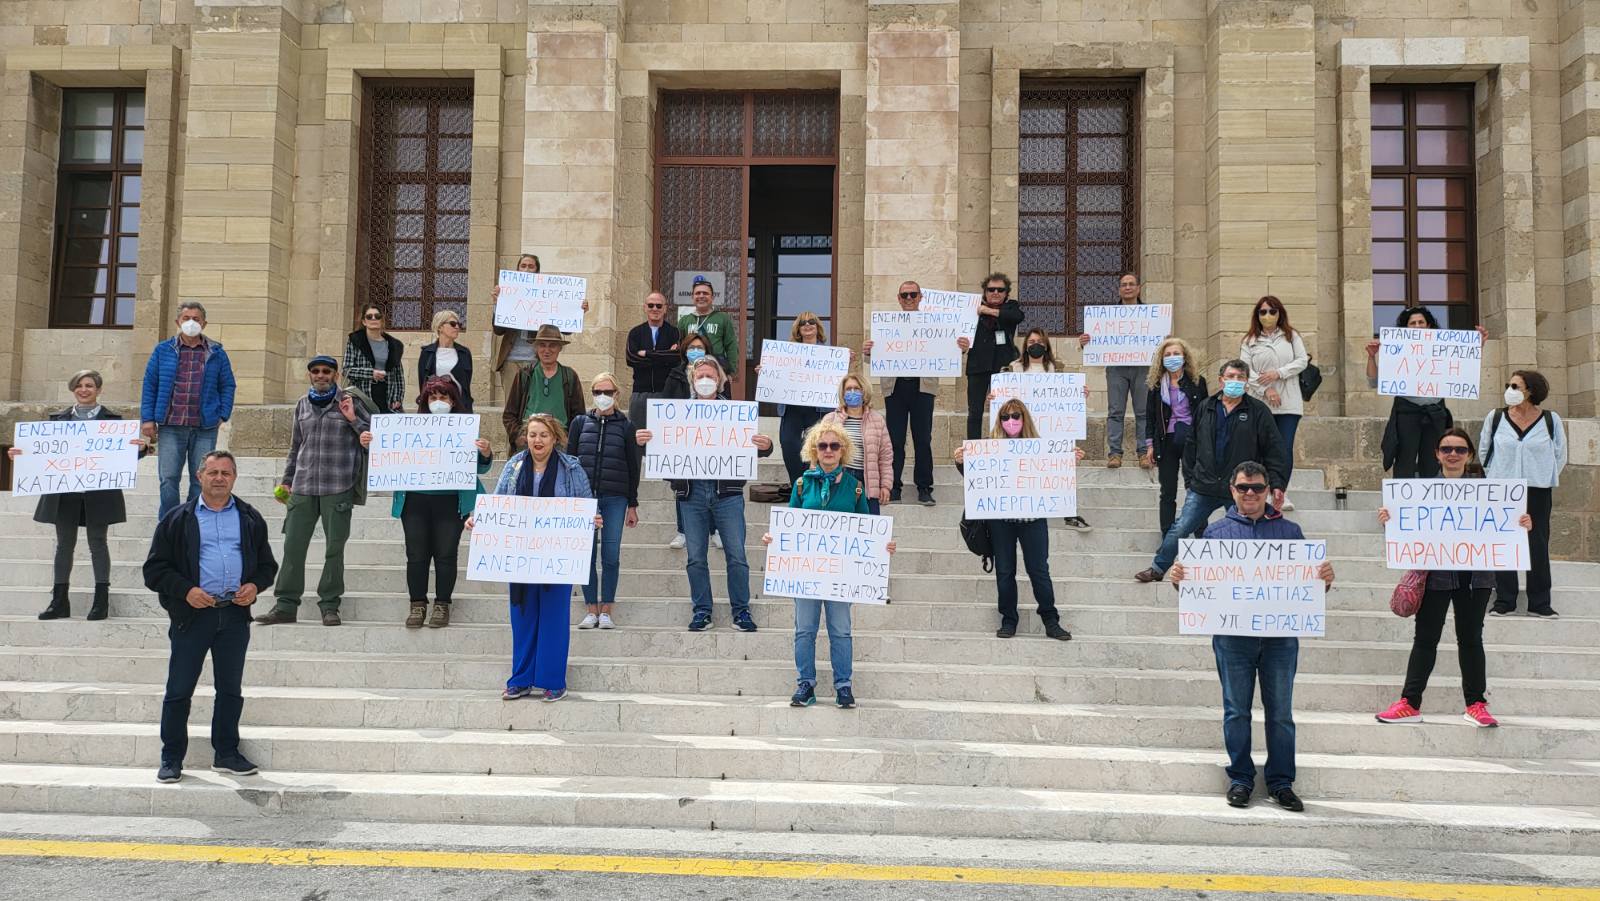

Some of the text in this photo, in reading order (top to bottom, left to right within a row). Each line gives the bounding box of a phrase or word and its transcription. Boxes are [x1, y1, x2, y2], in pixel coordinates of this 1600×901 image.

[537, 275, 544, 284] Η
[543, 290, 584, 300] ΕΡΓΑΣΙΑΣ
[515, 299, 559, 313] ΛΥΣΗ
[872, 313, 960, 323] ΕΝΣΗΜΑ ΞΕΝΑΓΩΝ
[878, 329, 900, 338] ΤΡΙΑ
[1093, 321, 1149, 334] ΑΜΕΣΗ
[1382, 329, 1420, 340] ΦΤΑΝΕΙ
[1437, 330, 1480, 343] ΚΟΡΟΙΔΙΑ
[764, 342, 843, 358] ΧΑΝΟΥΜΕ ΤΟ
[886, 341, 928, 352] ΧΩΡΙΣ
[1384, 344, 1403, 355] ΤΟΥ
[1432, 345, 1481, 359] ΕΡΓΑΣΙΑΣ
[872, 359, 959, 370] ΚΑΤΑΧΩΡΗΣΗ
[1084, 353, 1100, 363] ΤΩΝ
[1103, 352, 1148, 363] ΕΝΣΗΜΩΝ
[759, 369, 782, 379] ΜΑΣ
[1397, 357, 1460, 376] ΛΥΣΗ
[992, 374, 1074, 384] ΑΠΑΙΤΟΥΜΕ
[756, 387, 775, 398] ΤΟΥ
[1381, 380, 1478, 398] ΕΔΩ ΚΑΙ ΤΩΡΑ
[652, 403, 758, 421] ΤΟ ΥΠΟΥΡΓΕΙΟ
[19, 422, 138, 437] ΕΝΣΗΜΑ 2019
[374, 416, 474, 429] ΤΟ ΥΠΟΥΡΓΕΙΟ
[382, 433, 466, 448] ΕΡΓΑΣΙΑΣ
[663, 426, 755, 448] ΕΡΓΑΣΙΑΣ
[33, 440, 69, 455] 2020
[85, 438, 126, 451] 2021
[965, 440, 1074, 456] 2019 2020 2021
[45, 456, 104, 471] ΧΩΡΙΣ
[371, 451, 477, 467] ΕΜΠΑΙΖΕΙ ΤΟΥΣ
[647, 454, 753, 477] ΠΑΡΑΝΟΜΕΙ
[968, 459, 1076, 472] ΧΩΡΙΣ ΕΝΣΗΜΑ
[17, 472, 137, 493] ΚΑΤΑΧΩΡΗΣΗ
[369, 471, 475, 486] ΕΛΛΗΝΕΣ ΞΕΝΑΓΟΥΣ
[968, 476, 1076, 491] ΧΩΡΙΣ ΕΠΙΔΟΜΑ
[1386, 483, 1524, 501] ΤΟ ΥΠΟΥΡΓΕΙΟ
[478, 496, 585, 512] ΑΠΑΙΤΟΥΜΕ
[476, 512, 595, 530] ΑΜΕΣΗ ΚΑΤΑΒΟΛΗ
[772, 511, 888, 535] ΤΟ ΥΠΟΥΡΓΕΙΟ
[1400, 506, 1516, 532] ΕΡΓΑΣΙΑΣ
[473, 534, 590, 552] ΤΟΥ ΕΠΙΔΟΜΑΤΟΣ
[780, 533, 876, 558] ΕΡΓΑΣΙΑΣ
[1182, 540, 1325, 560] ΧΑΝΟΥΜΕ ΤΟ
[1387, 541, 1519, 568] ΠΑΡΑΝΟΜΕΙ
[767, 556, 888, 578] ΕΜΠΑΙΖΕΙ ΤΟΥΣ
[1183, 566, 1245, 581] ΕΠΙΔΟΜΑ
[766, 579, 888, 600] ΕΛΛΗΝΕΣ ΞΕΝΑΓΟΥΣ
[1180, 586, 1314, 601] ΜΑΣ ΕΞΑΙΤΙΑΣ
[1180, 612, 1207, 628] ΤΟΥ
[1252, 614, 1324, 632] ΕΡΓΑΣΙΑΣ
